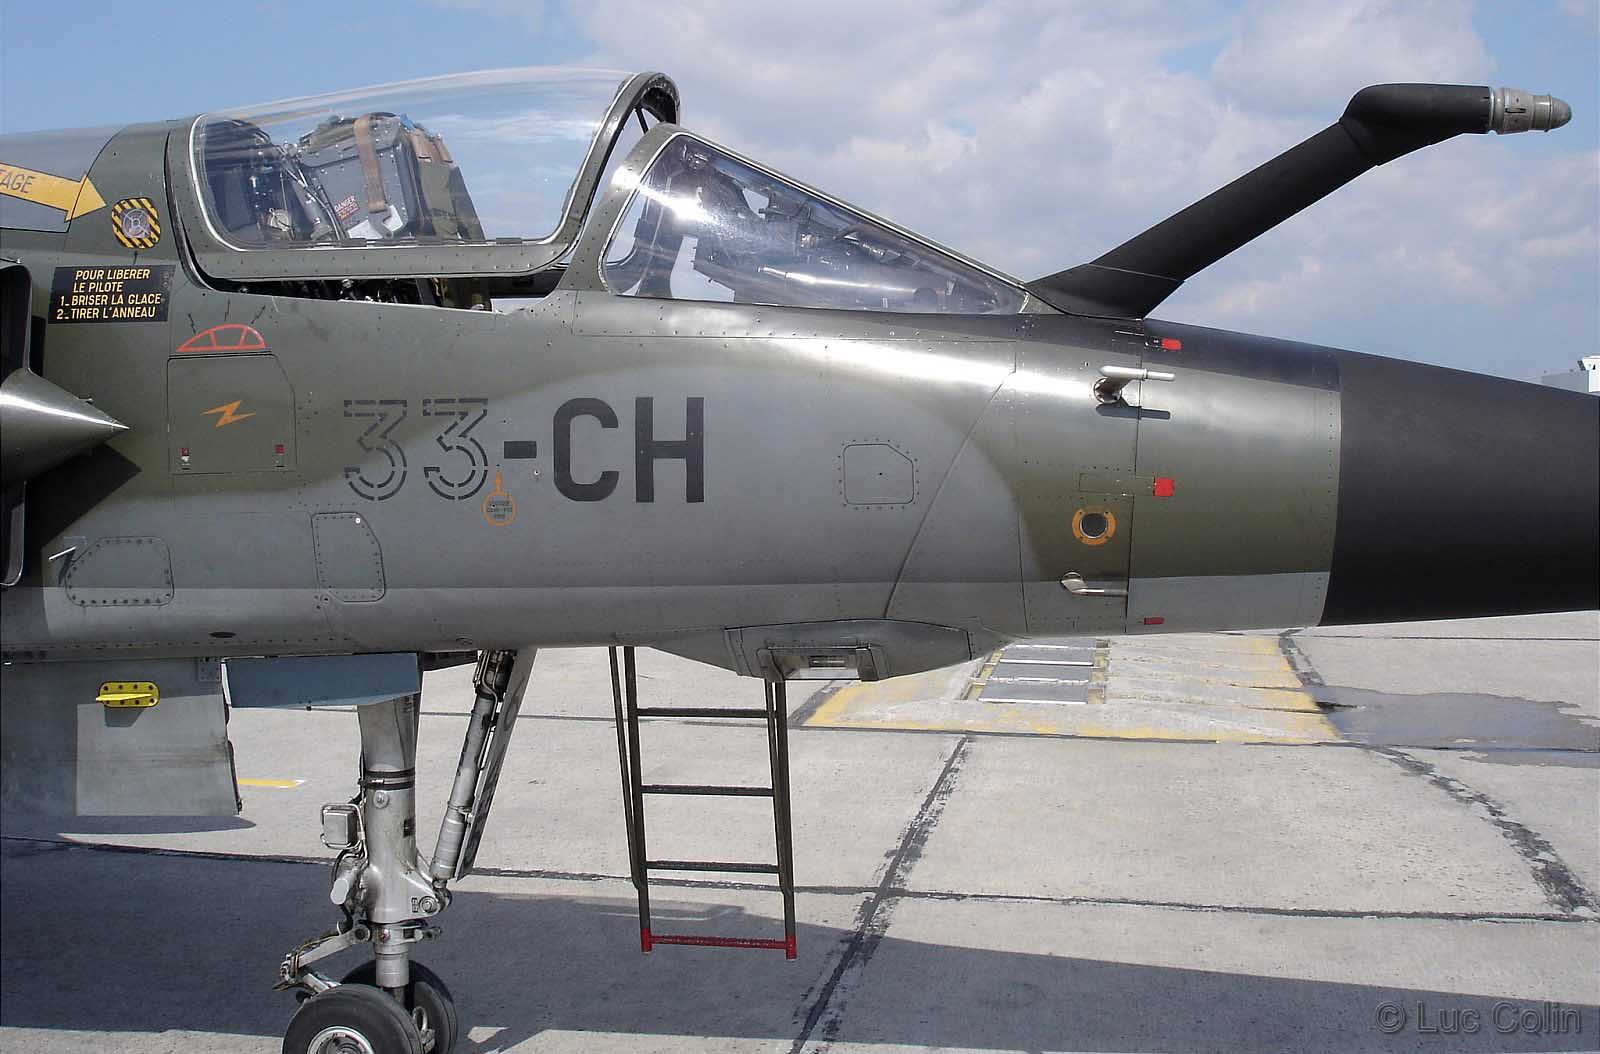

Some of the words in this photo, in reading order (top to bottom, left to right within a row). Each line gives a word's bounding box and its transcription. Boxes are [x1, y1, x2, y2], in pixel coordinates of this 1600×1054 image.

[75, 270, 105, 280] POUR
[107, 269, 151, 280] LIBERER
[73, 282, 86, 293] LE
[88, 281, 124, 293] PILOTE
[111, 294, 124, 305] LA
[127, 293, 162, 305] GLACE
[102, 306, 156, 319] L'ANNEAU
